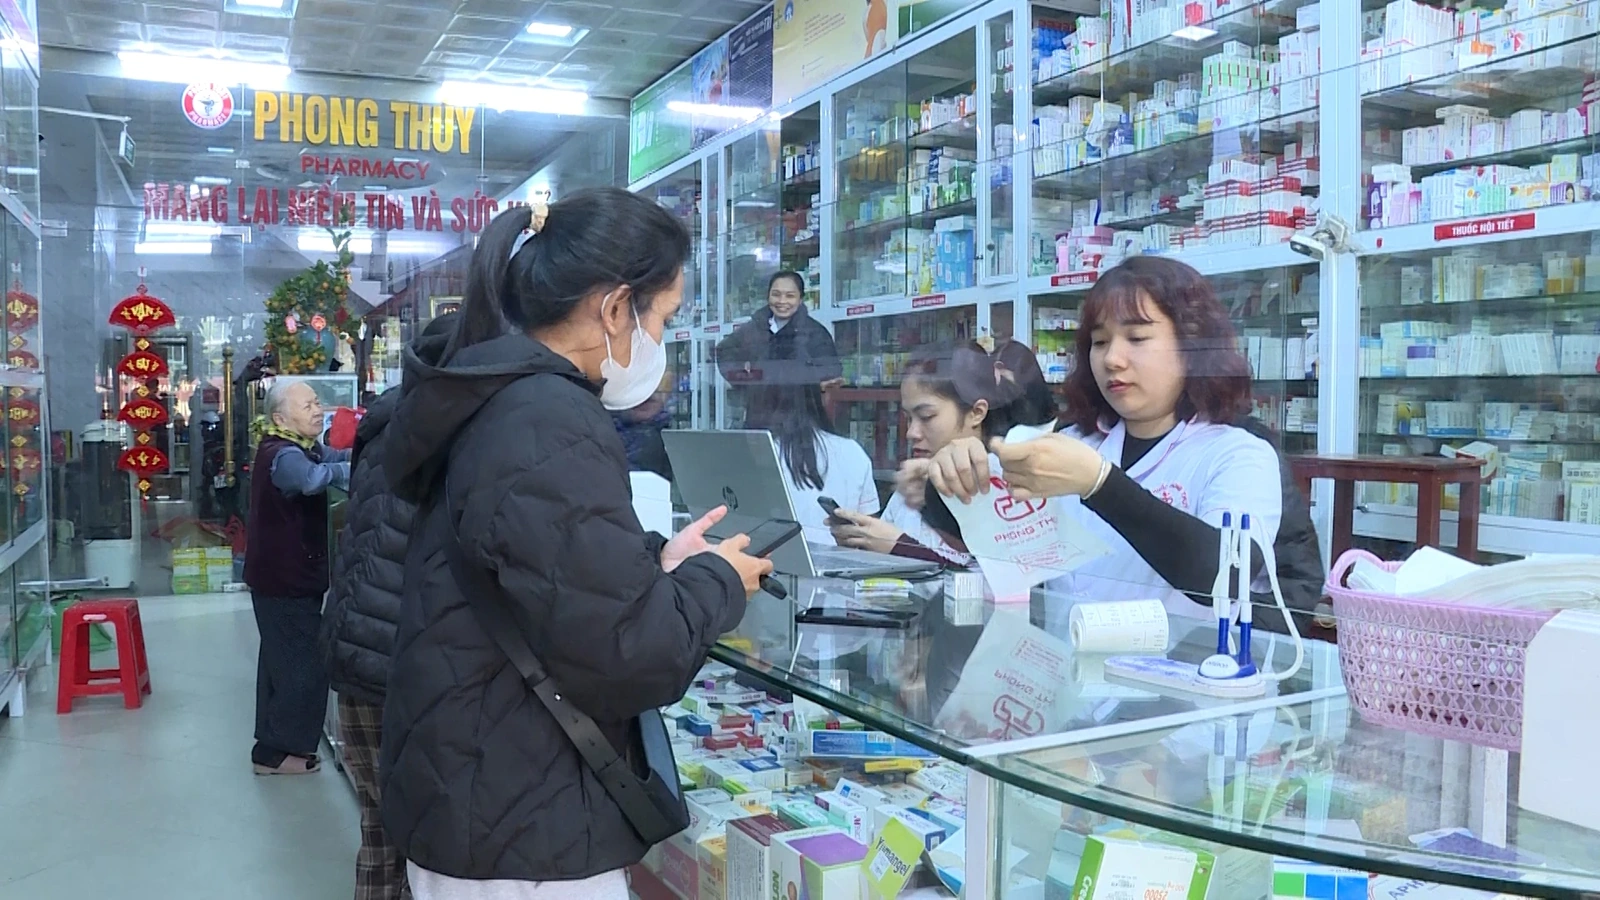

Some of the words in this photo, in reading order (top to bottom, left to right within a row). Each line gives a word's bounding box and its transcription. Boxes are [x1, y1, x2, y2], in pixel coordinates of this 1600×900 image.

[254, 91, 379, 148] PHONG
[301, 154, 431, 180] PHARMACY
[144, 182, 228, 223] MANG
[237, 185, 279, 231] LẠI
[364, 194, 404, 231] TIN
[411, 188, 443, 232] VÀ
[450, 188, 499, 233] SỨC
[1452, 223, 1478, 237] THUỐC
[1480, 220, 1495, 234] NỘI
[1497, 217, 1515, 230] TIẾT
[994, 526, 1035, 543] PHONG
[876, 836, 911, 877] Yumangel
